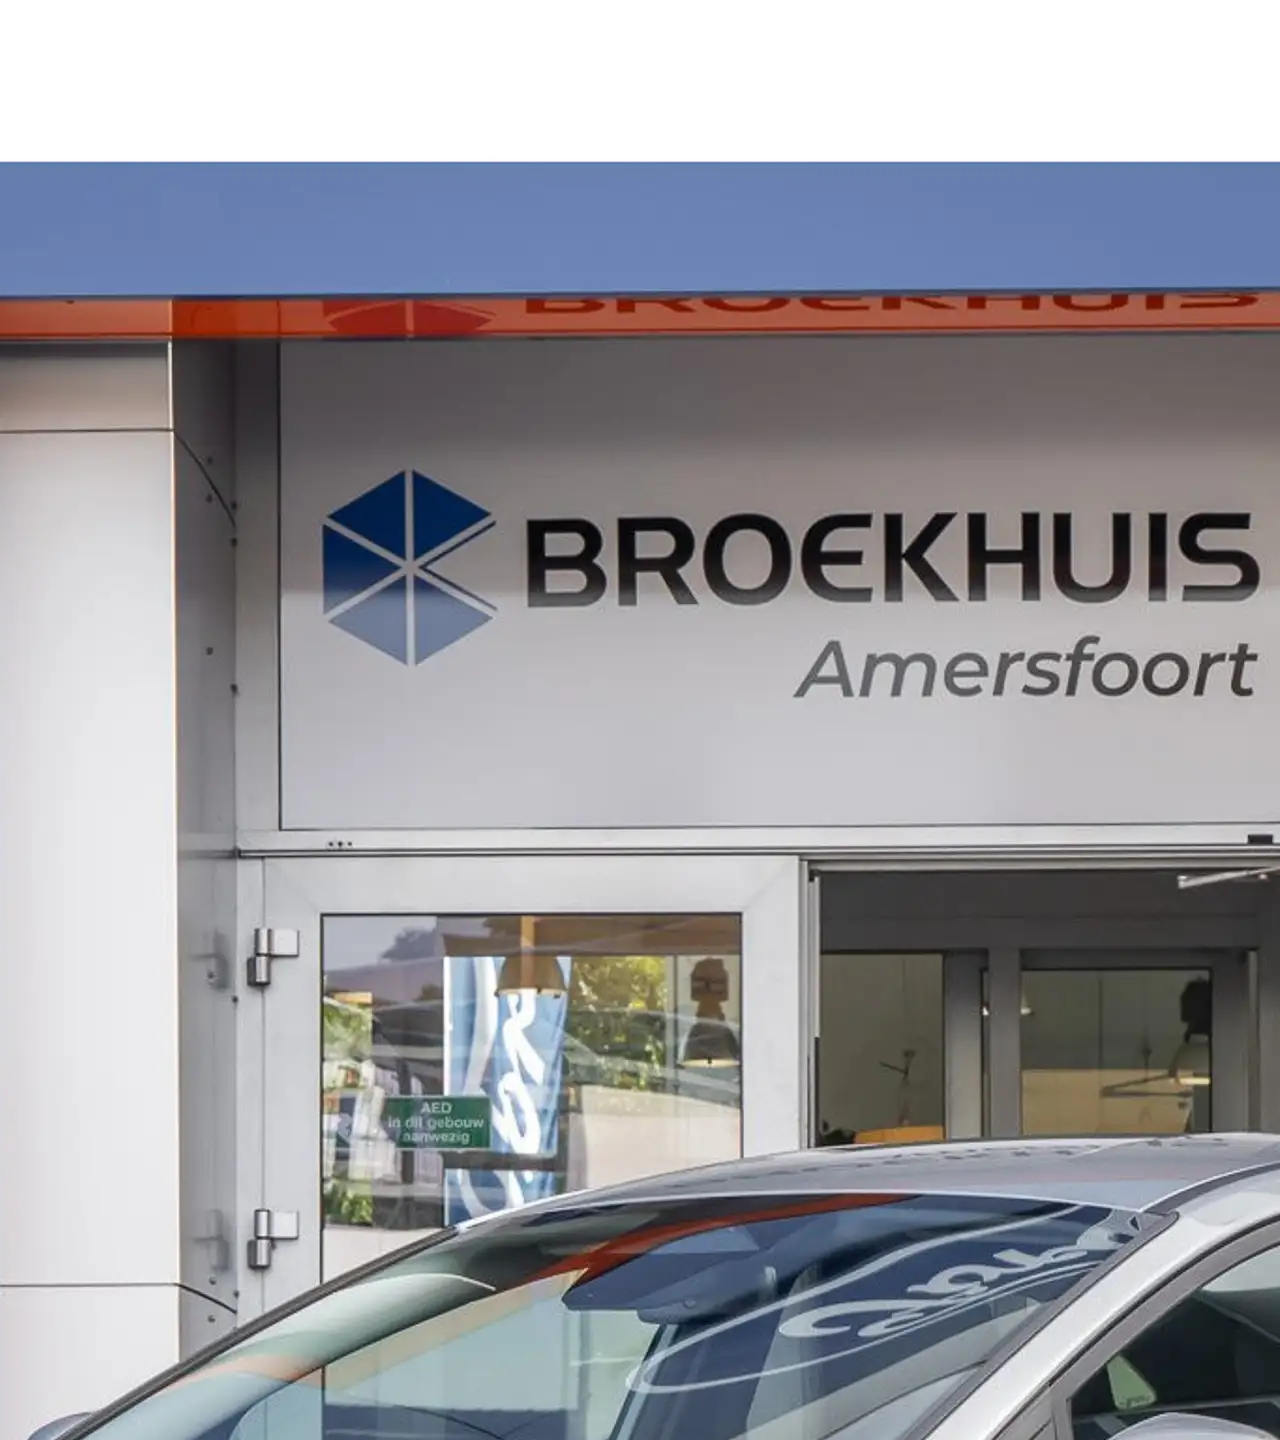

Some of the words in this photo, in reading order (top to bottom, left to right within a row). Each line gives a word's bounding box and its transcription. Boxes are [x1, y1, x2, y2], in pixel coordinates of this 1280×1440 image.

[527, 512, 1259, 606] BROEKHUIS
[794, 636, 1258, 697] Amersfoort
[421, 1101, 453, 1114] AED
[405, 1115, 422, 1128] dit
[427, 1115, 484, 1131] gebouw
[404, 1131, 470, 1144] aanwezig
